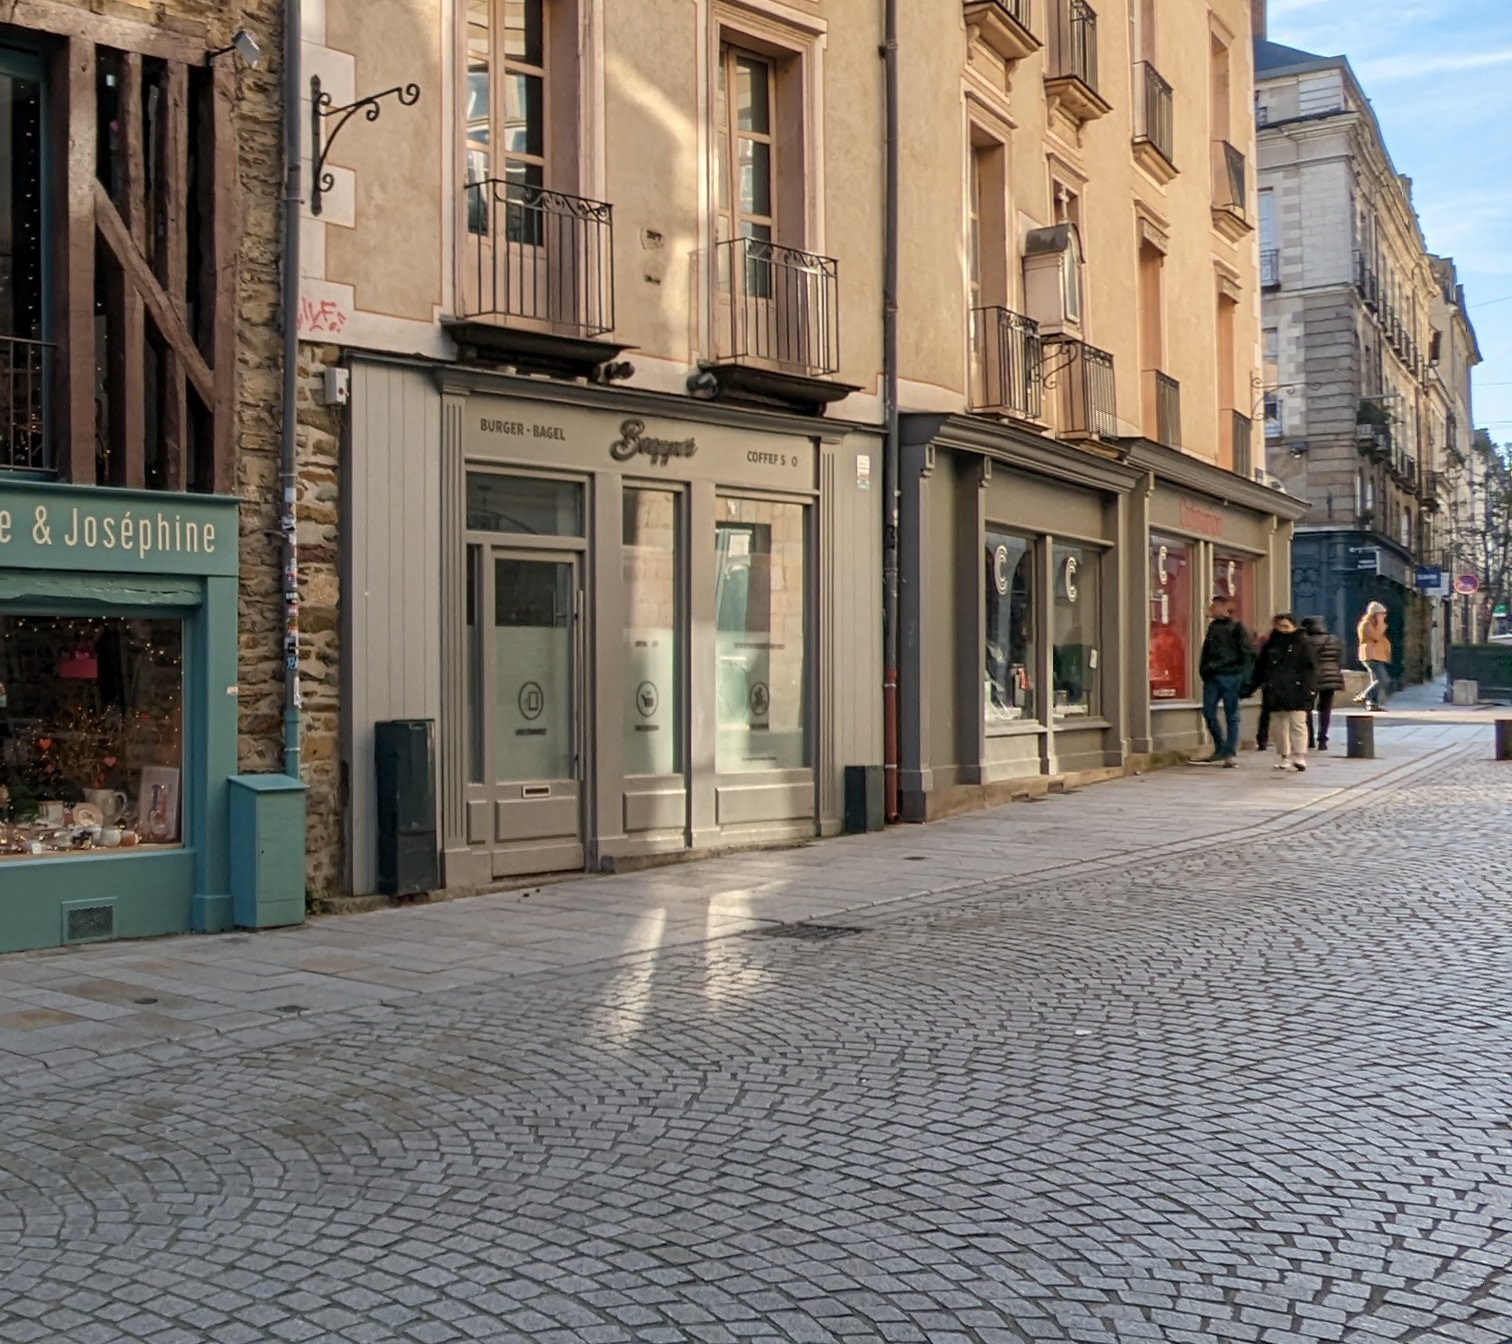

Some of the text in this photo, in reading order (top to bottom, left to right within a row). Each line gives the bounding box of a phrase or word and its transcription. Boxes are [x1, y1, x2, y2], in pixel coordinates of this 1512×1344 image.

[480, 418, 525, 437] BURGER
[533, 424, 566, 441] BAGEL
[32, 504, 53, 545] &
[64, 506, 217, 559] Joséphine
